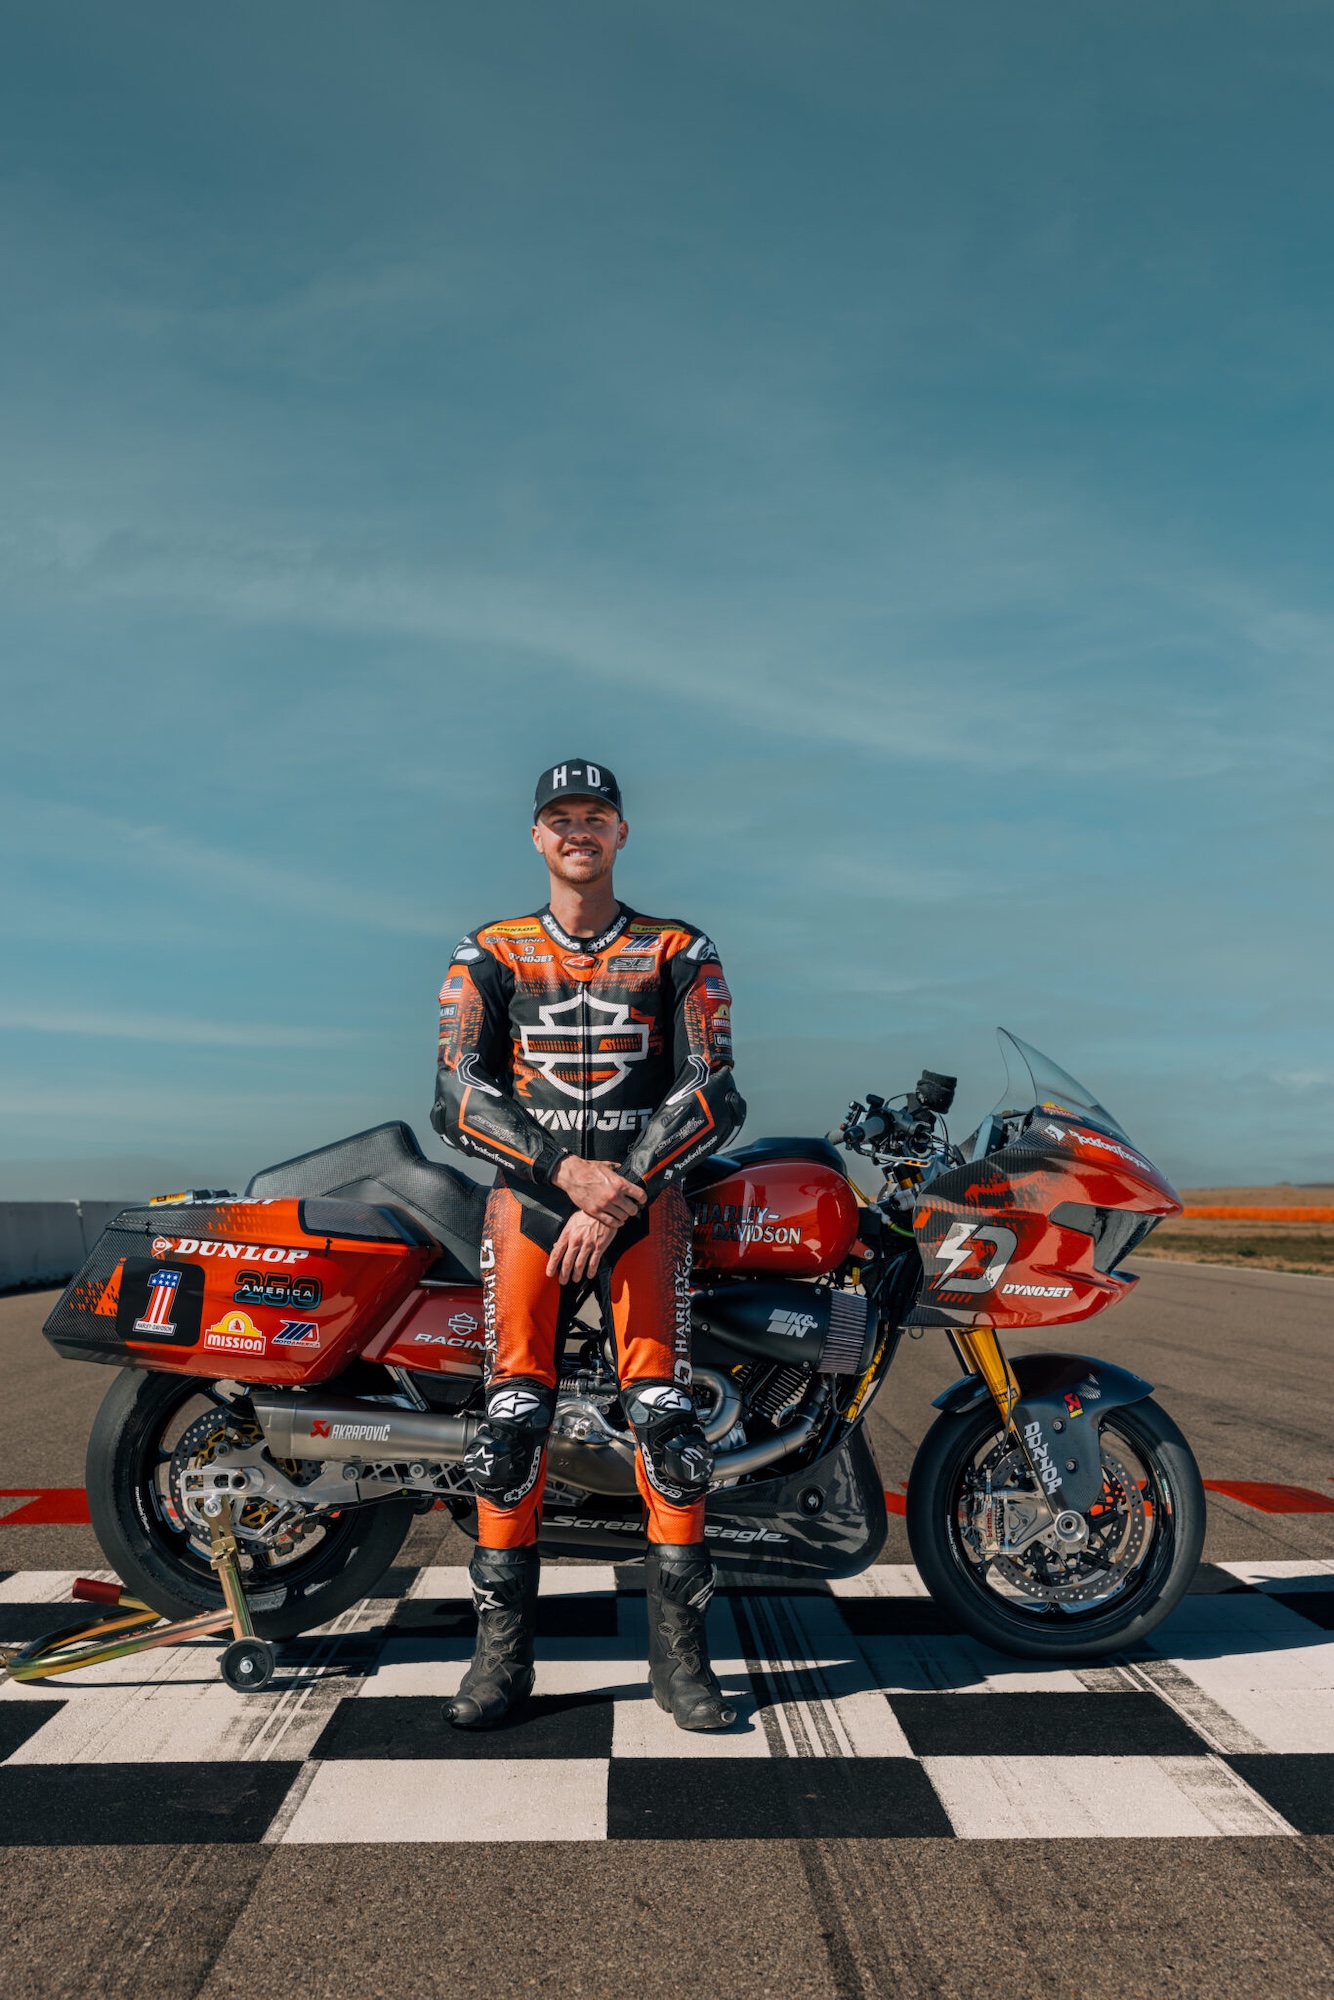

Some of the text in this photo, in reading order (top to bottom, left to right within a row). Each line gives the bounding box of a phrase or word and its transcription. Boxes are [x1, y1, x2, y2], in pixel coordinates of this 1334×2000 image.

[712, 1222, 802, 1245] DAVIDSON
[174, 1238, 309, 1265] DUNLOP
[234, 1269, 323, 1310] 250
[241, 1284, 312, 1297] AMERICA
[1001, 1283, 1074, 1298] DYNOJET
[414, 1333, 486, 1351] RACIN
[331, 1424, 391, 1441] AKRAPOVIČ
[1024, 1421, 1063, 1495] DUNLOP
[542, 1515, 790, 1543] Screa Eagle
